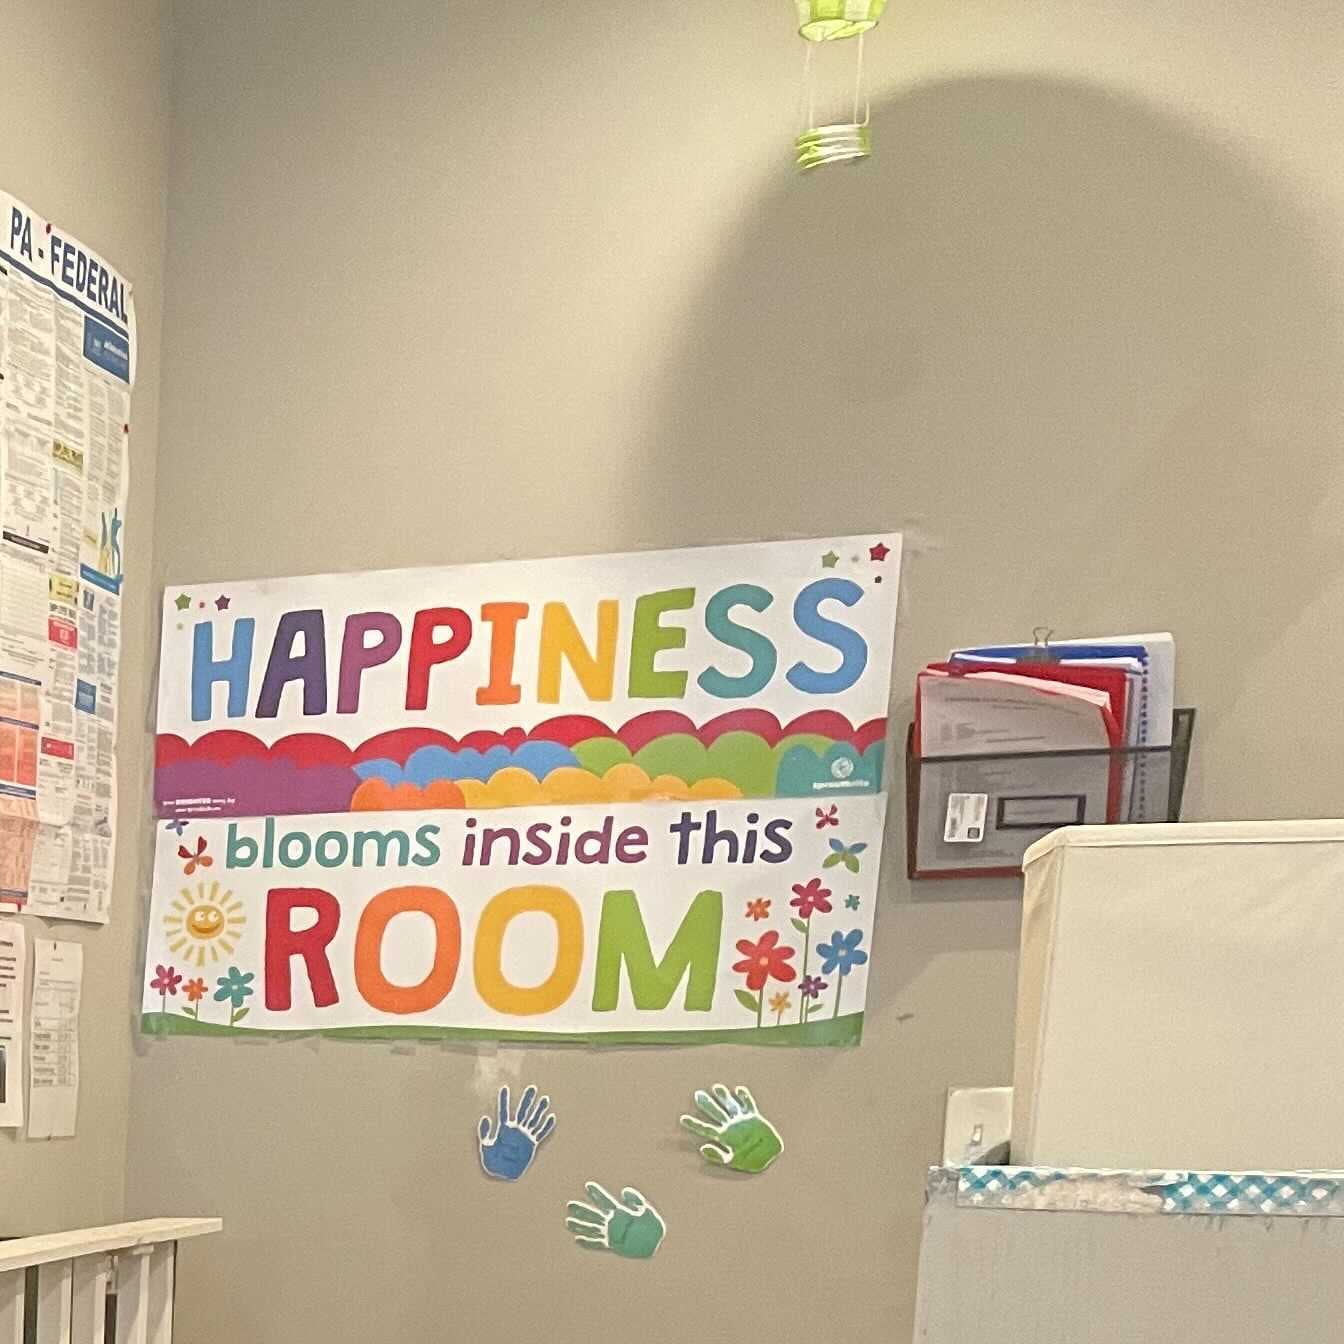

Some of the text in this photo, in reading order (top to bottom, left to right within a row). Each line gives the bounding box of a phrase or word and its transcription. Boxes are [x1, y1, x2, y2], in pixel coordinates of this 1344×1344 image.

[10, 205, 130, 326] PA FEDERAL
[188, 574, 871, 723] HAPPINESS
[224, 809, 795, 872] blooms inside this
[263, 882, 725, 1018] ROOM
